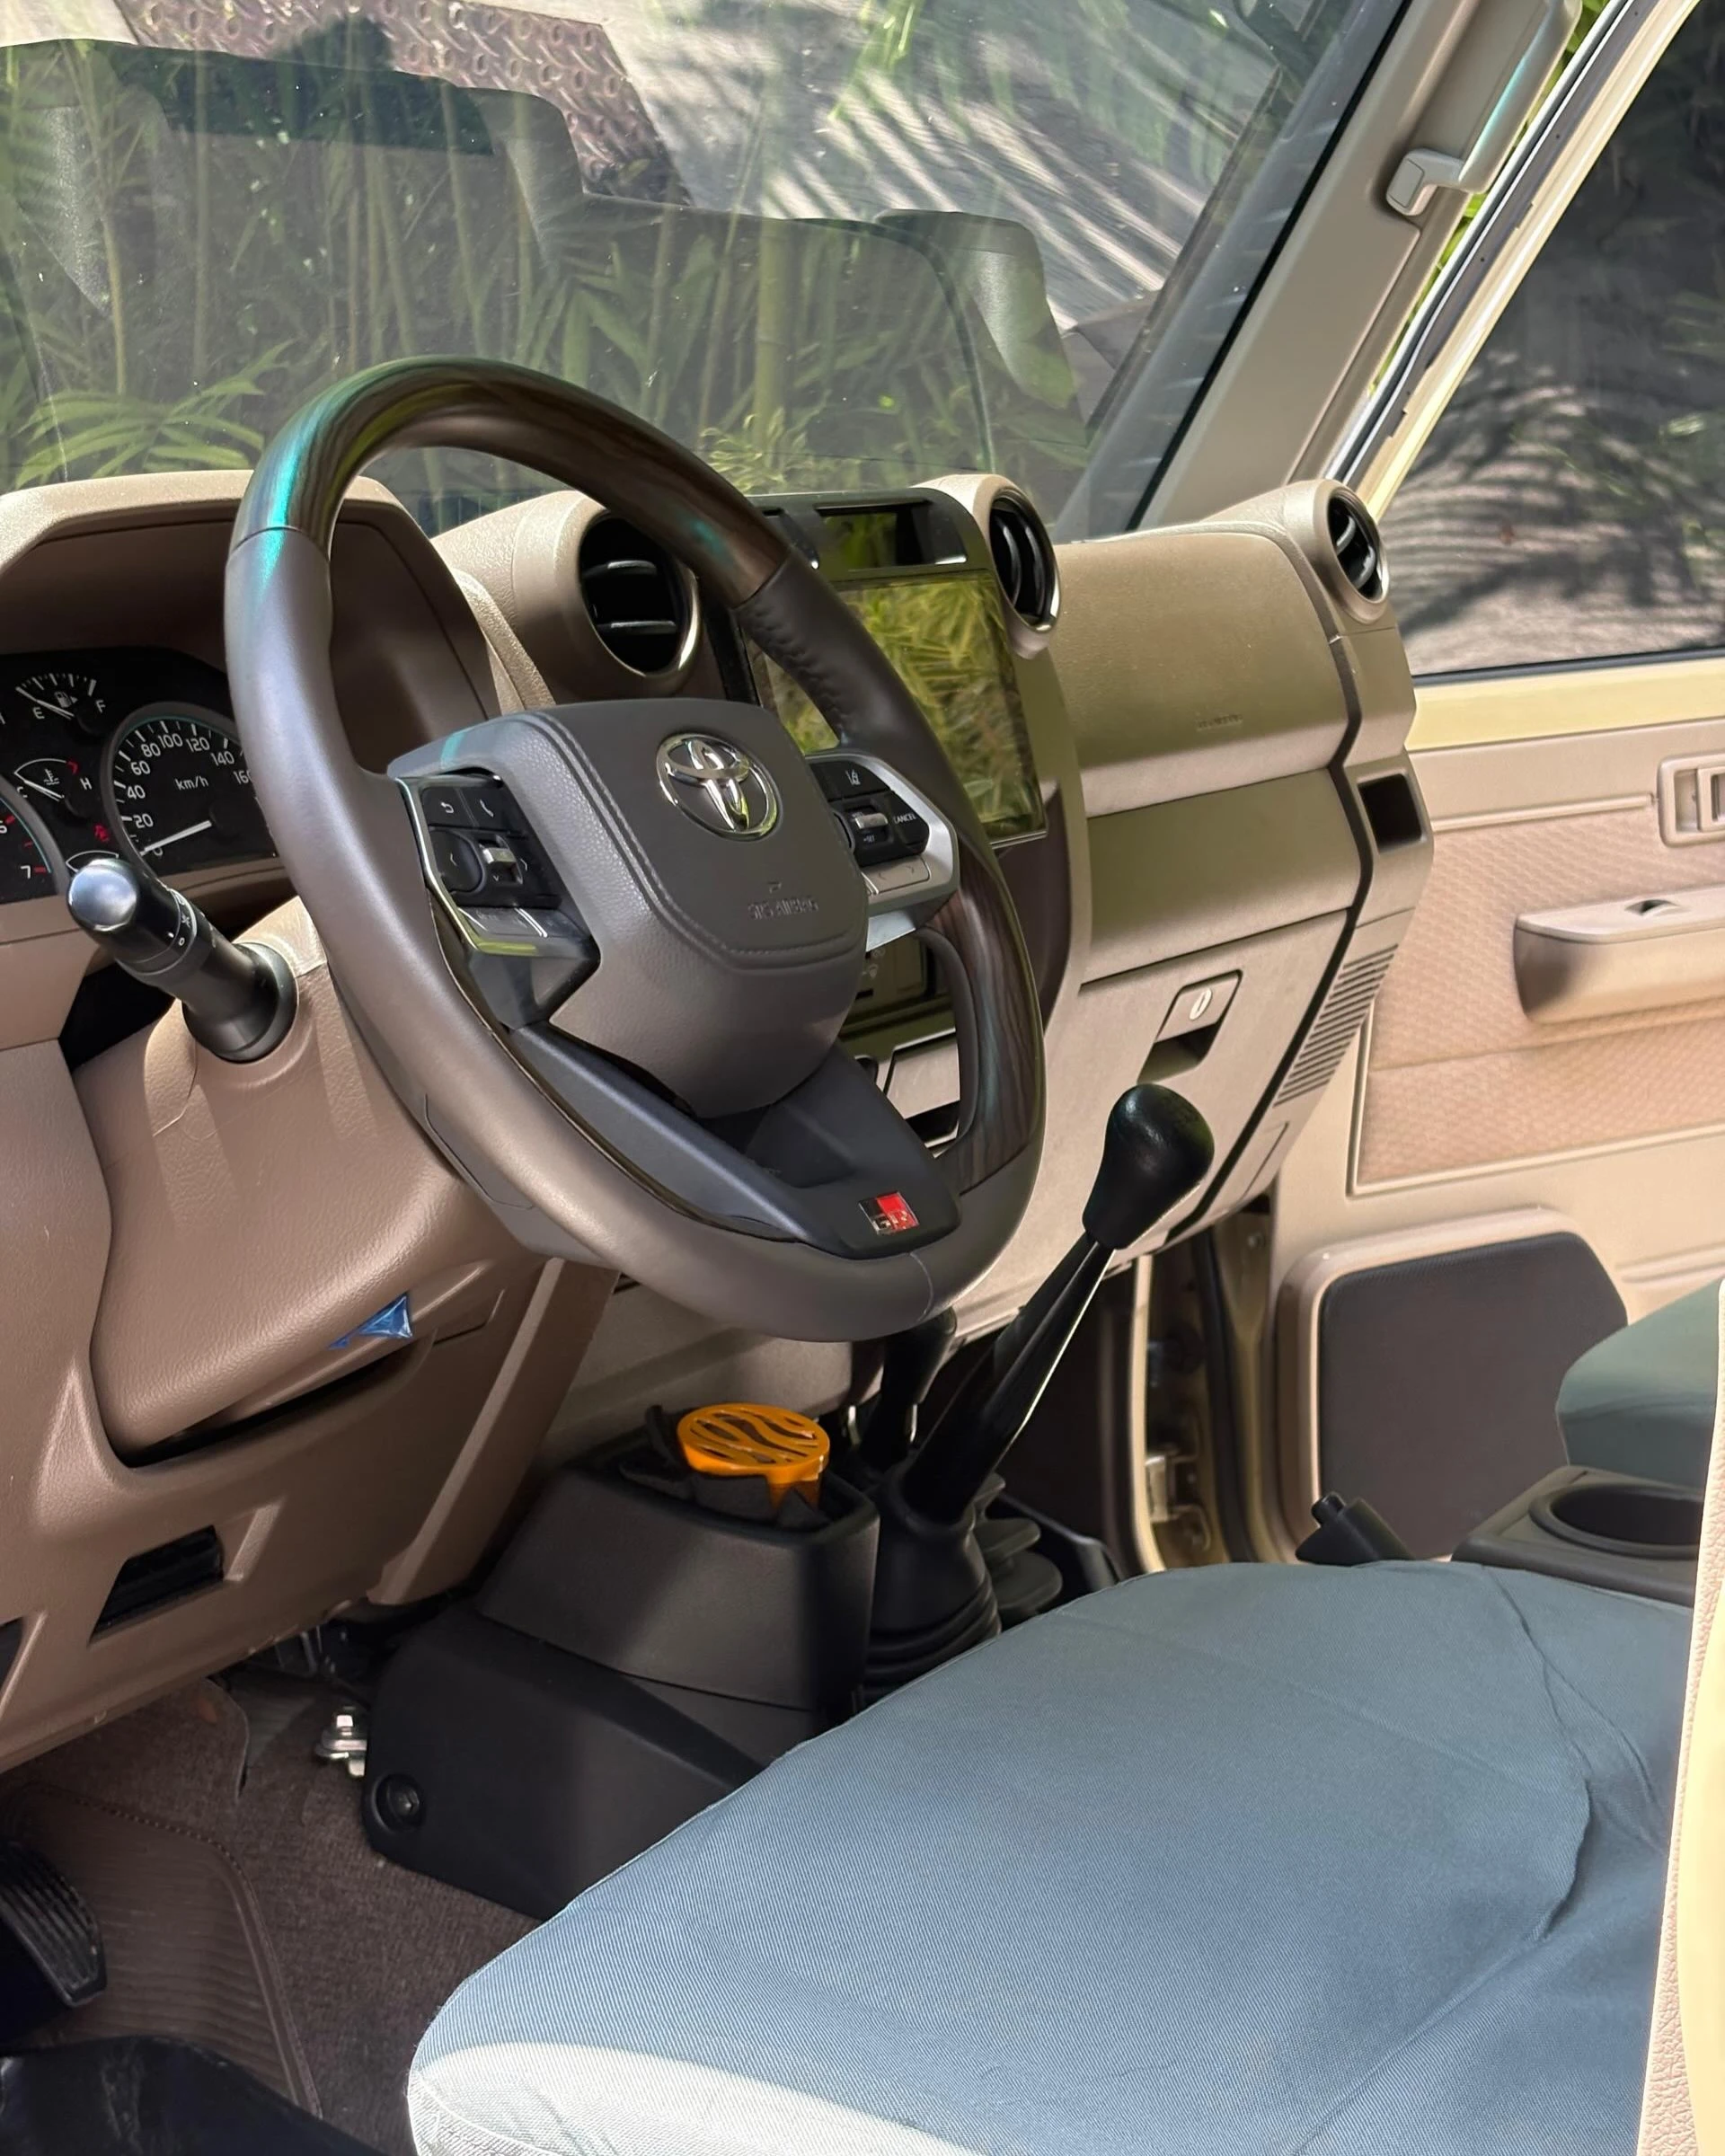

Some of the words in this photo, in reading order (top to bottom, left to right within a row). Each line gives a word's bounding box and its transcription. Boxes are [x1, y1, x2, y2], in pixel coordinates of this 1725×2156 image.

[32, 707, 45, 720] E
[95, 699, 106, 713] F
[158, 732, 183, 749] 100
[186, 736, 211, 753] 120
[142, 742, 162, 758] 80
[210, 750, 235, 766] 140
[130, 760, 151, 776] 60
[80, 777, 93, 791] H
[175, 775, 209, 791] km/h
[127, 783, 146, 800] 40
[134, 813, 155, 829] 20
[20, 865, 31, 879] 7
